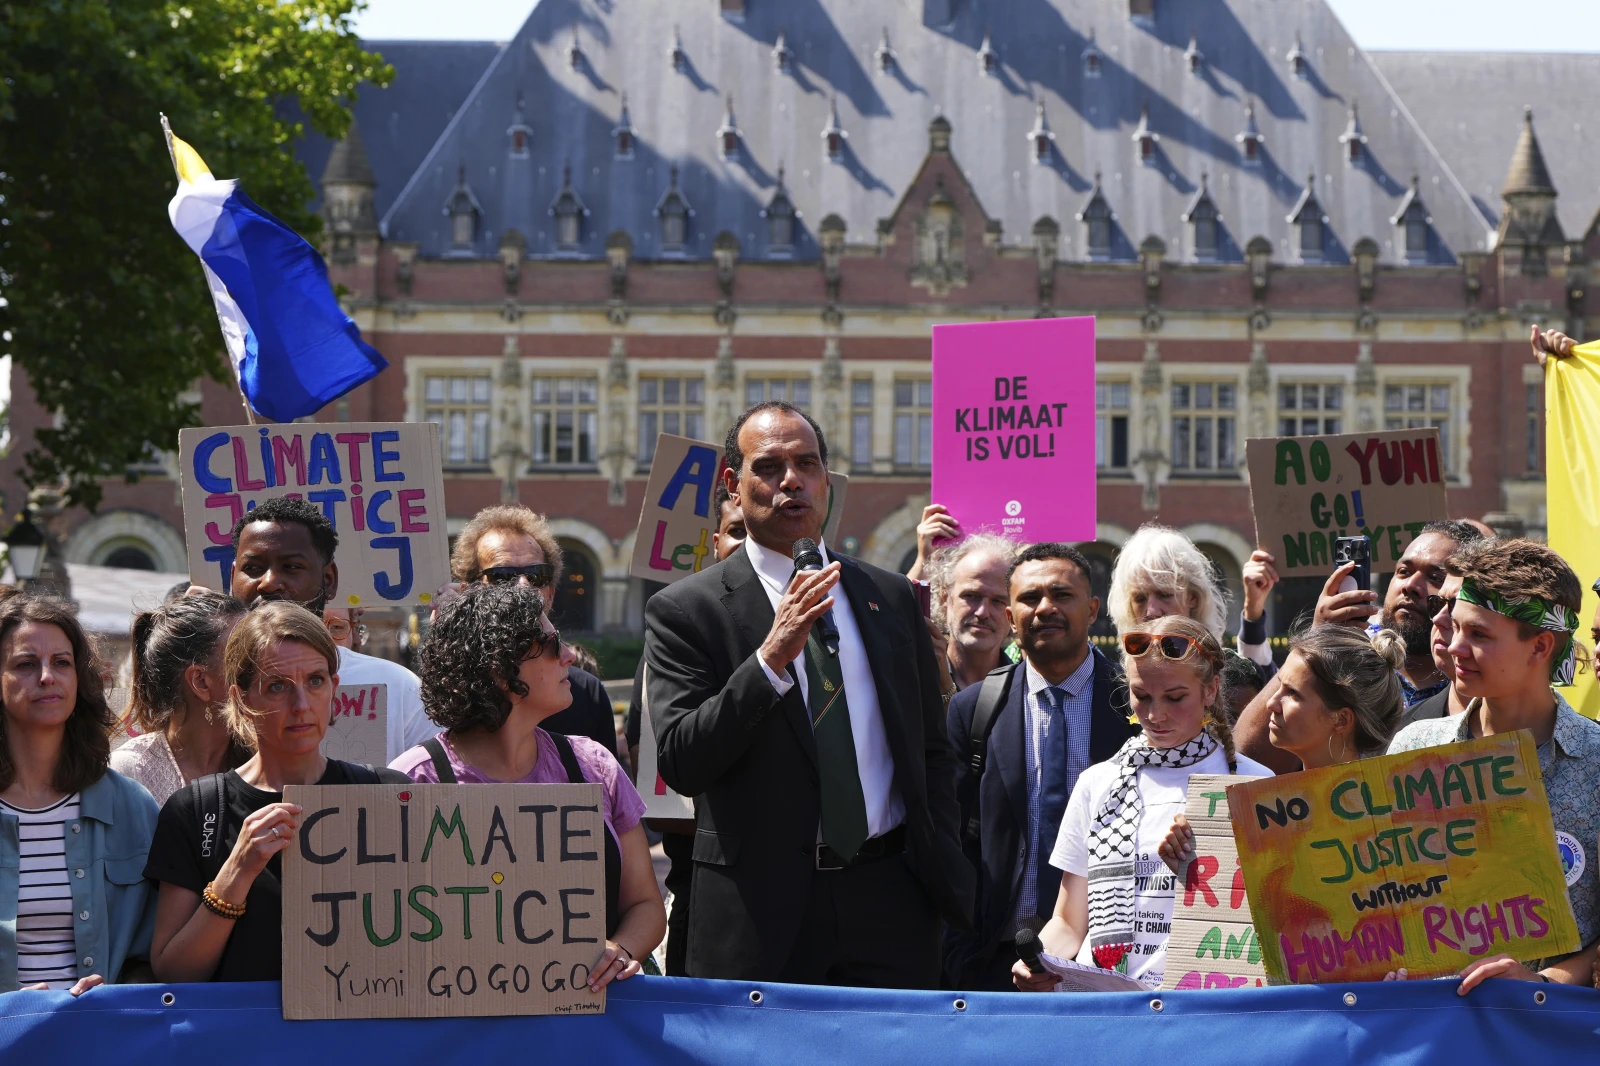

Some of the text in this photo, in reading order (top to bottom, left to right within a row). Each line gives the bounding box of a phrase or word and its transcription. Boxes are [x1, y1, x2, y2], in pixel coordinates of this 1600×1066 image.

[994, 376, 1028, 401] DE
[955, 403, 1068, 433] KLIMAAT
[966, 433, 1055, 461] IS VOL!
[1002, 517, 1025, 526] OXFAM
[1310, 490, 1366, 529] GO!
[1255, 755, 1527, 830] NO CLIMATE
[201, 812, 216, 857] DAKINE
[1310, 819, 1477, 884] JUSTICE
[1560, 835, 1579, 853] YOUTH
[1351, 874, 1449, 911] WITHOUT
[1138, 910, 1165, 921] taking
[1278, 917, 1405, 984] HUMAN
[324, 961, 404, 1002] Yumi
